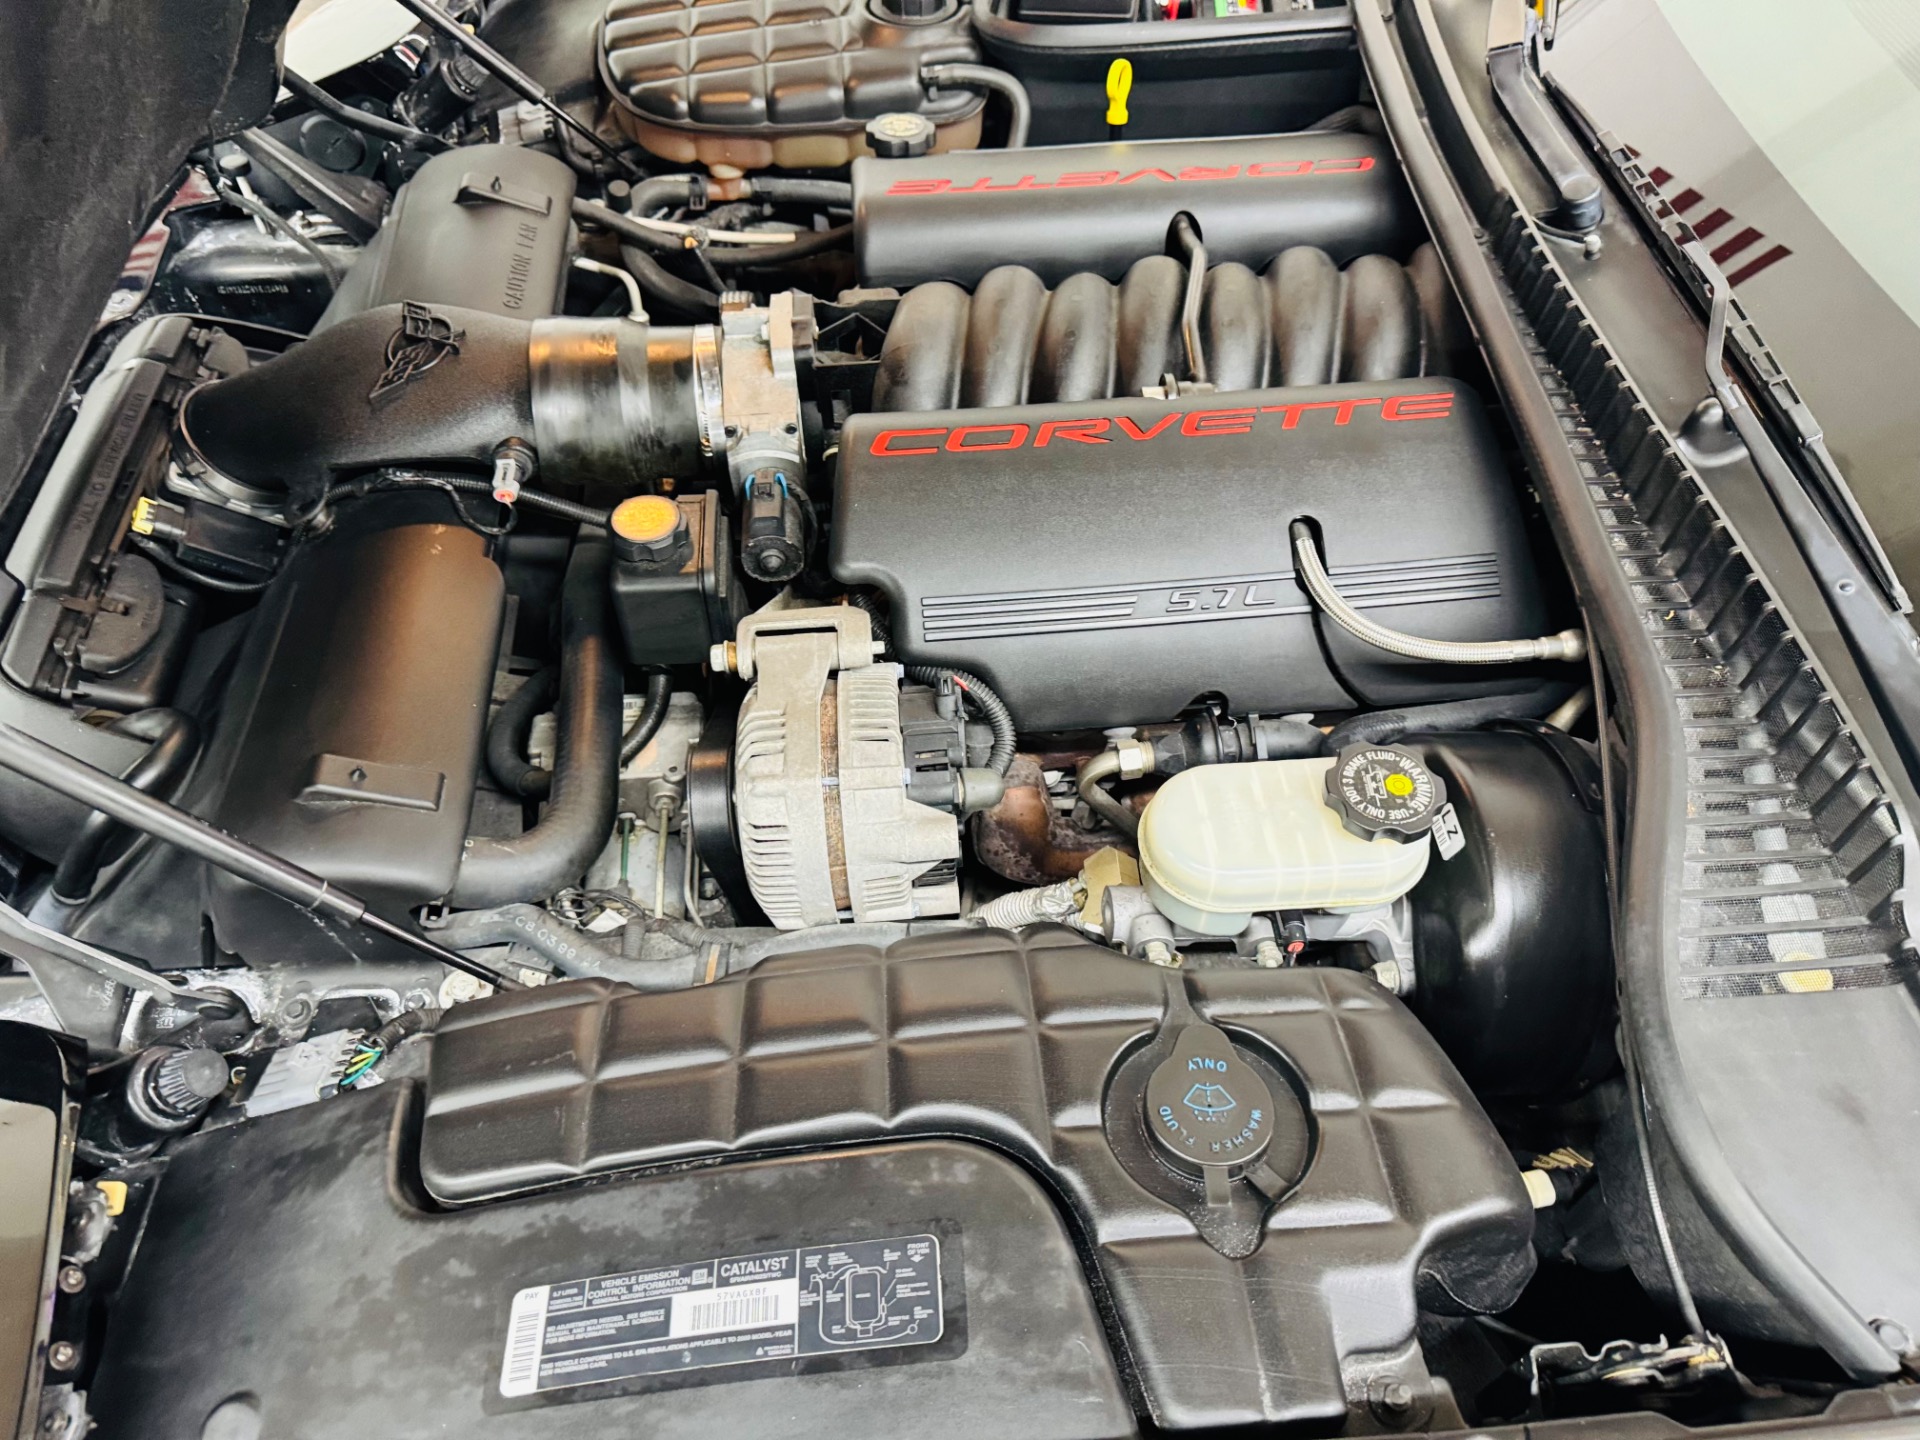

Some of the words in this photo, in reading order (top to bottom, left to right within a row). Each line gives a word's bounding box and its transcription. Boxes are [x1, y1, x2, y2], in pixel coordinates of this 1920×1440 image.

[885, 156, 1376, 196] CORVETTE
[503, 253, 531, 309] CAUTION
[868, 393, 1455, 456] CORVETTE
[1166, 585, 1276, 613] 5.7L
[1342, 754, 1368, 777] BRAKE
[1365, 751, 1395, 761] FLUID
[1343, 786, 1361, 803] DOT
[1398, 756, 1432, 812] WARNING
[1357, 801, 1386, 819] ONLY
[1388, 808, 1410, 820] USE
[1188, 1057, 1227, 1072] ONLY
[1159, 1105, 1196, 1146] FLUID
[1211, 1109, 1262, 1152] WASHER
[721, 1256, 789, 1278] CATALYST
[587, 1287, 629, 1299] CONTROL
[632, 1277, 691, 1293] INFORMATION
[601, 1276, 637, 1288] VEHICLE
[638, 1269, 680, 1283] EMISSION
[524, 1292, 539, 1300] PAY
